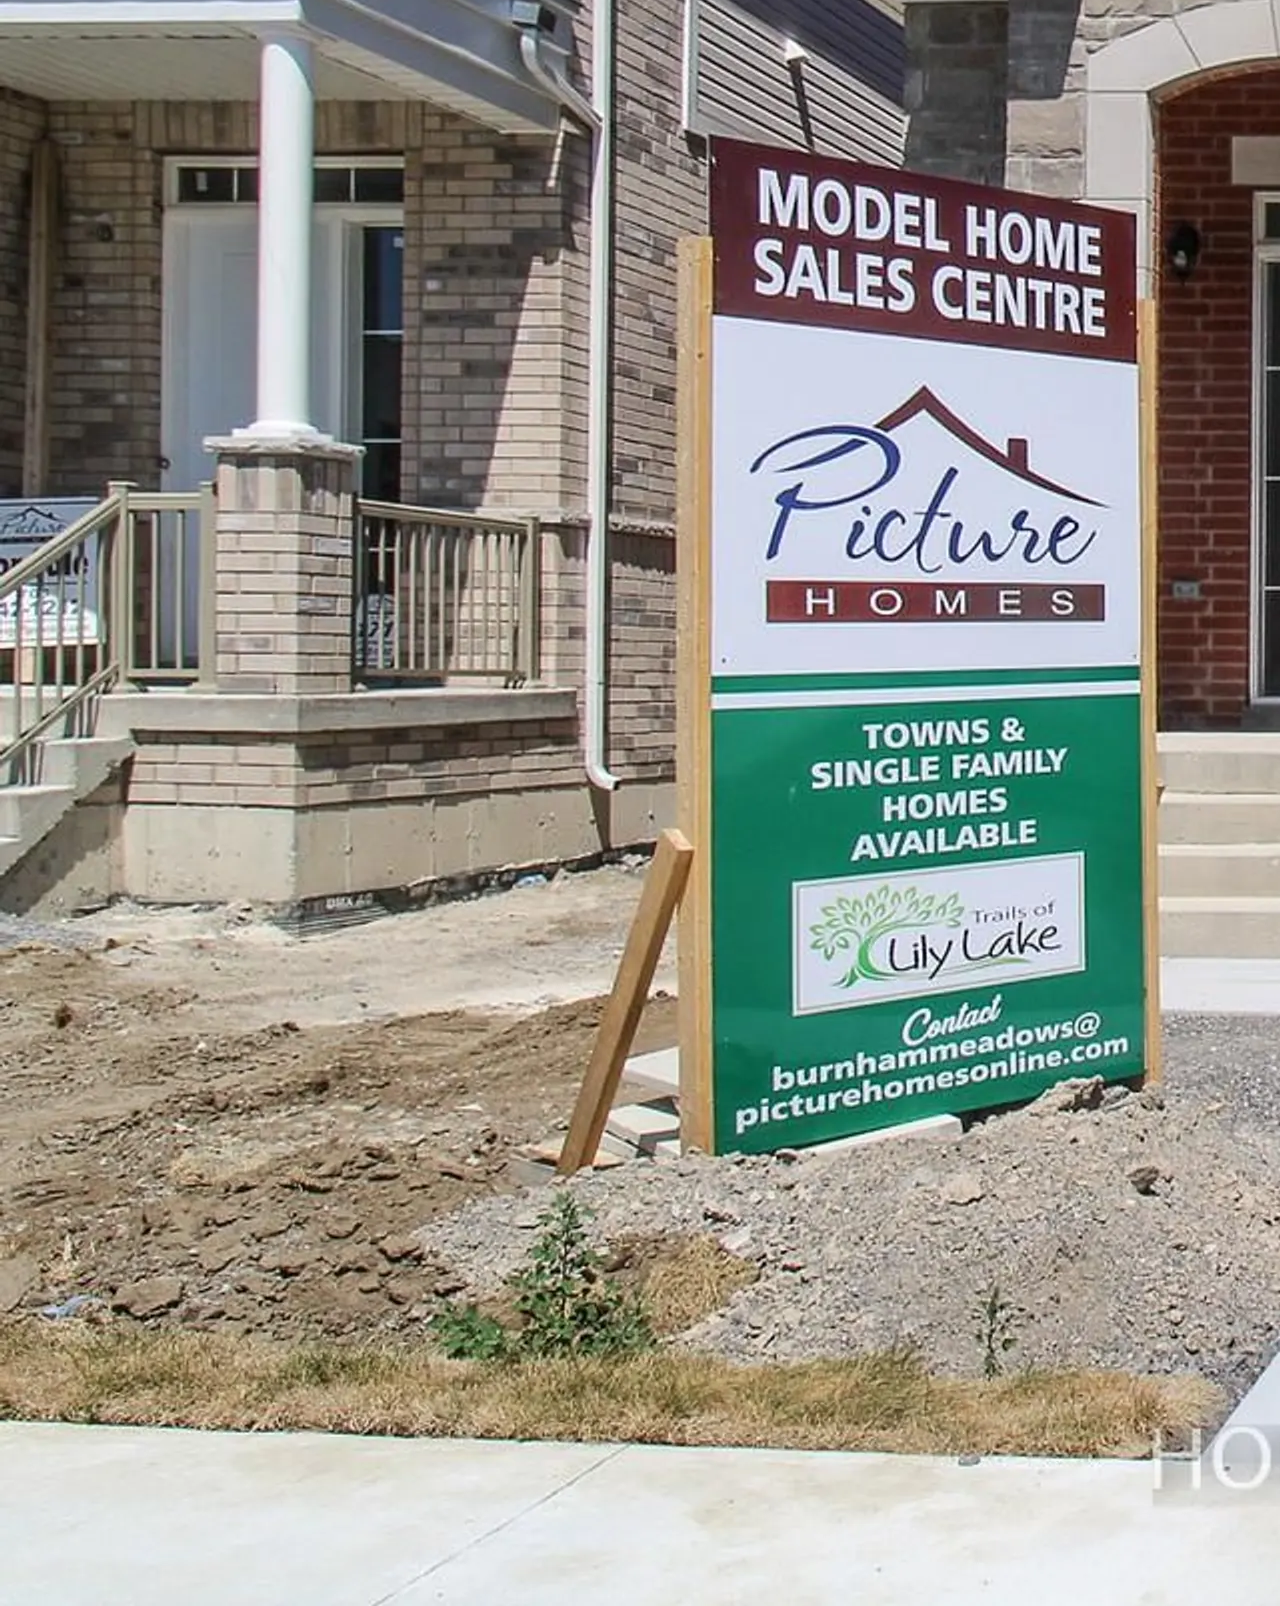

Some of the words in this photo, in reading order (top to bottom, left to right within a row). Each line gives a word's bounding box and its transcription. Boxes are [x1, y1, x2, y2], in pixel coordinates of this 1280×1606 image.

[757, 168, 950, 253] MODEL
[965, 205, 1102, 277] HOME
[753, 238, 916, 314] SALES
[931, 266, 1107, 338] CENTRE
[750, 424, 1097, 574] Picture
[804, 588, 1075, 616] HOMES
[862, 717, 990, 750] TOWNS
[1001, 717, 1026, 743] &
[810, 755, 941, 790] SINGLE
[951, 747, 1068, 780] FAMILY
[882, 787, 1008, 822] HOMES
[850, 819, 1038, 862] AVAILABLE
[973, 904, 1027, 924] Trails
[1033, 900, 1055, 916] of
[889, 934, 954, 980] Lily
[962, 921, 1062, 962] Lake
[902, 994, 1001, 1047] Contact
[771, 1011, 1101, 1093] burnhammeadows@
[734, 1036, 1130, 1134] picturehomesonline.com
